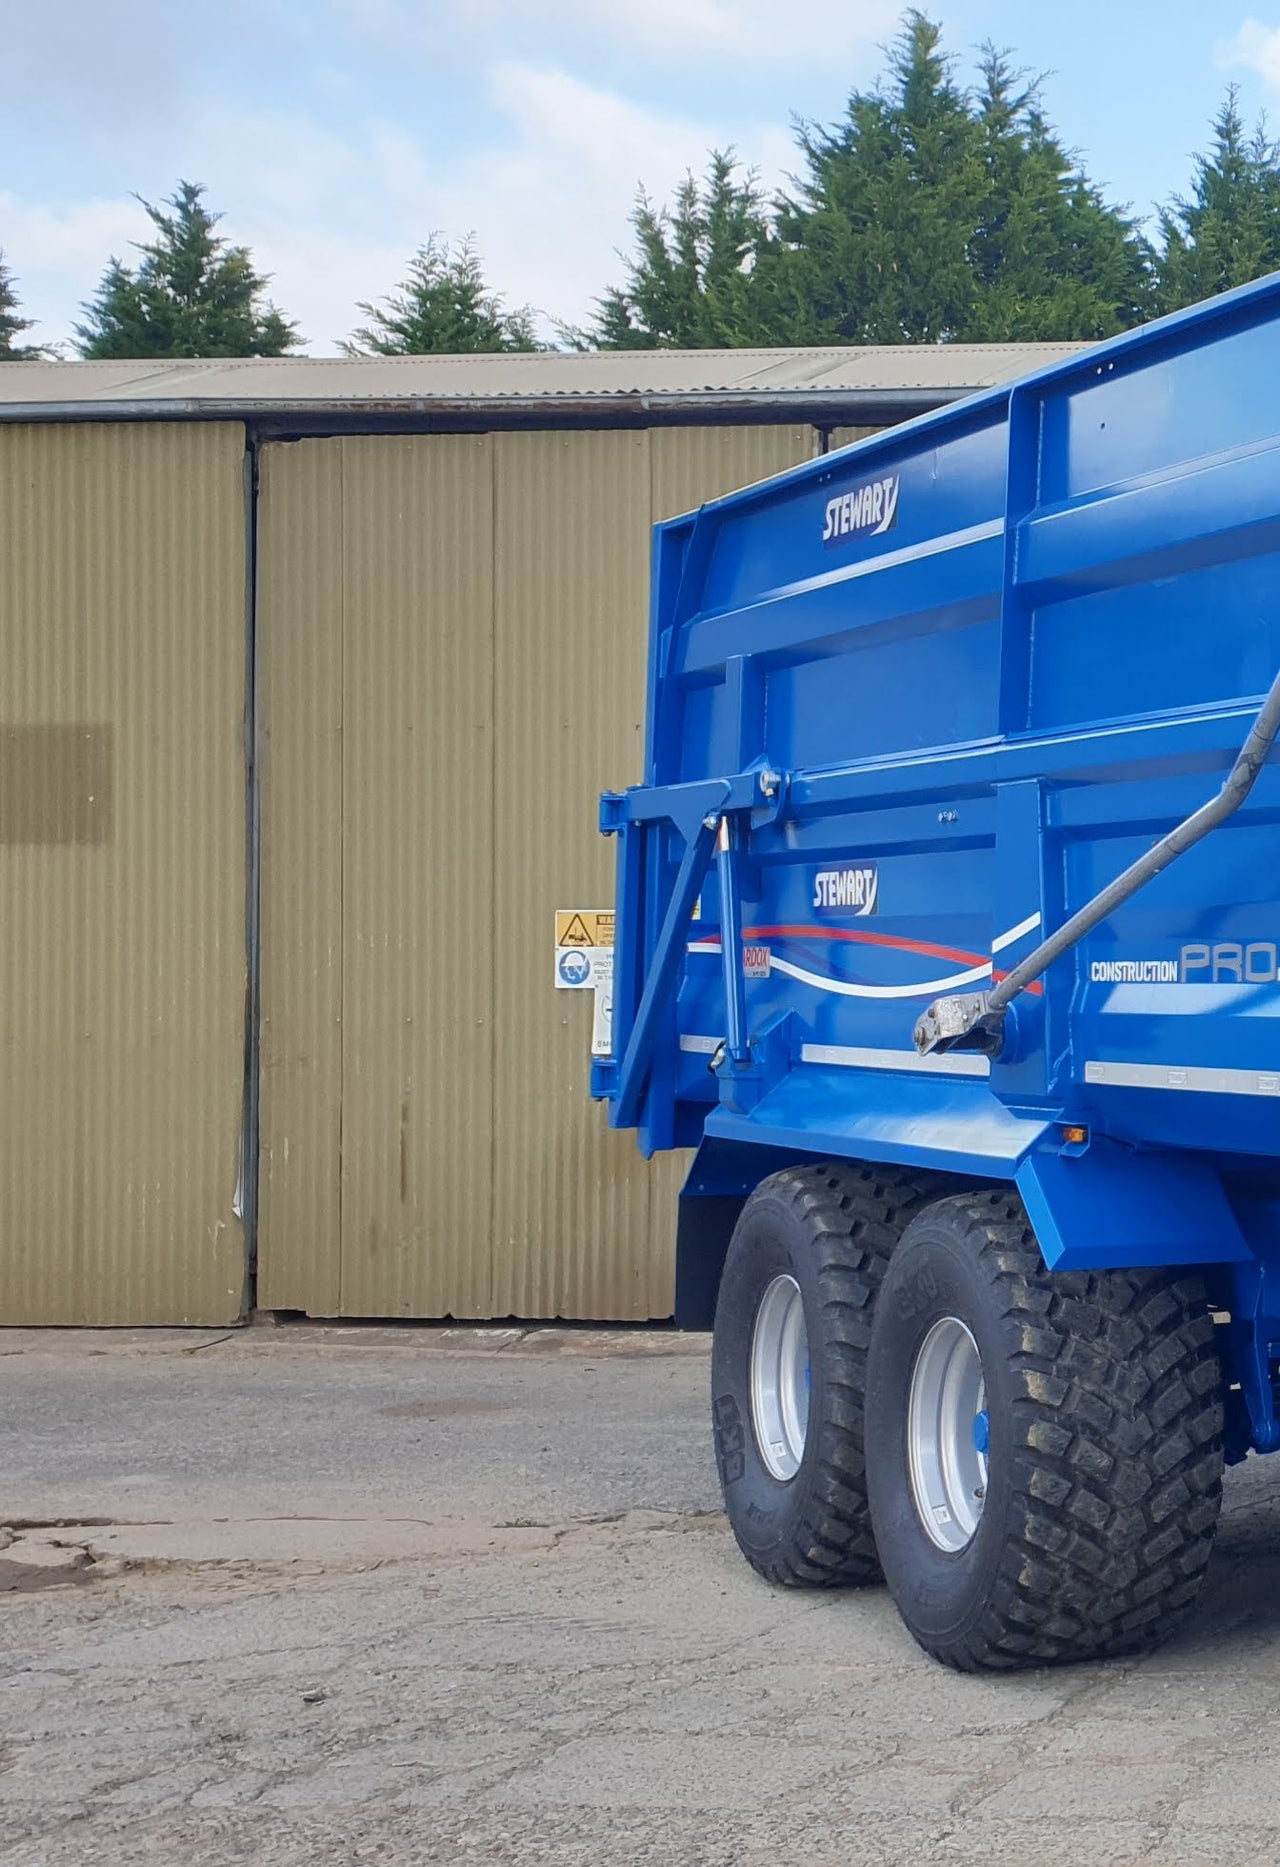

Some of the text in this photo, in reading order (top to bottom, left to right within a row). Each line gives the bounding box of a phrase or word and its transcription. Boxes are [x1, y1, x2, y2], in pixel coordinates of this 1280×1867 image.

[822, 474, 899, 541] STEWART
[813, 868, 878, 916] STEWART
[1091, 961, 1178, 982] CONSTRUCTION
[1181, 942, 1277, 983] PRO
